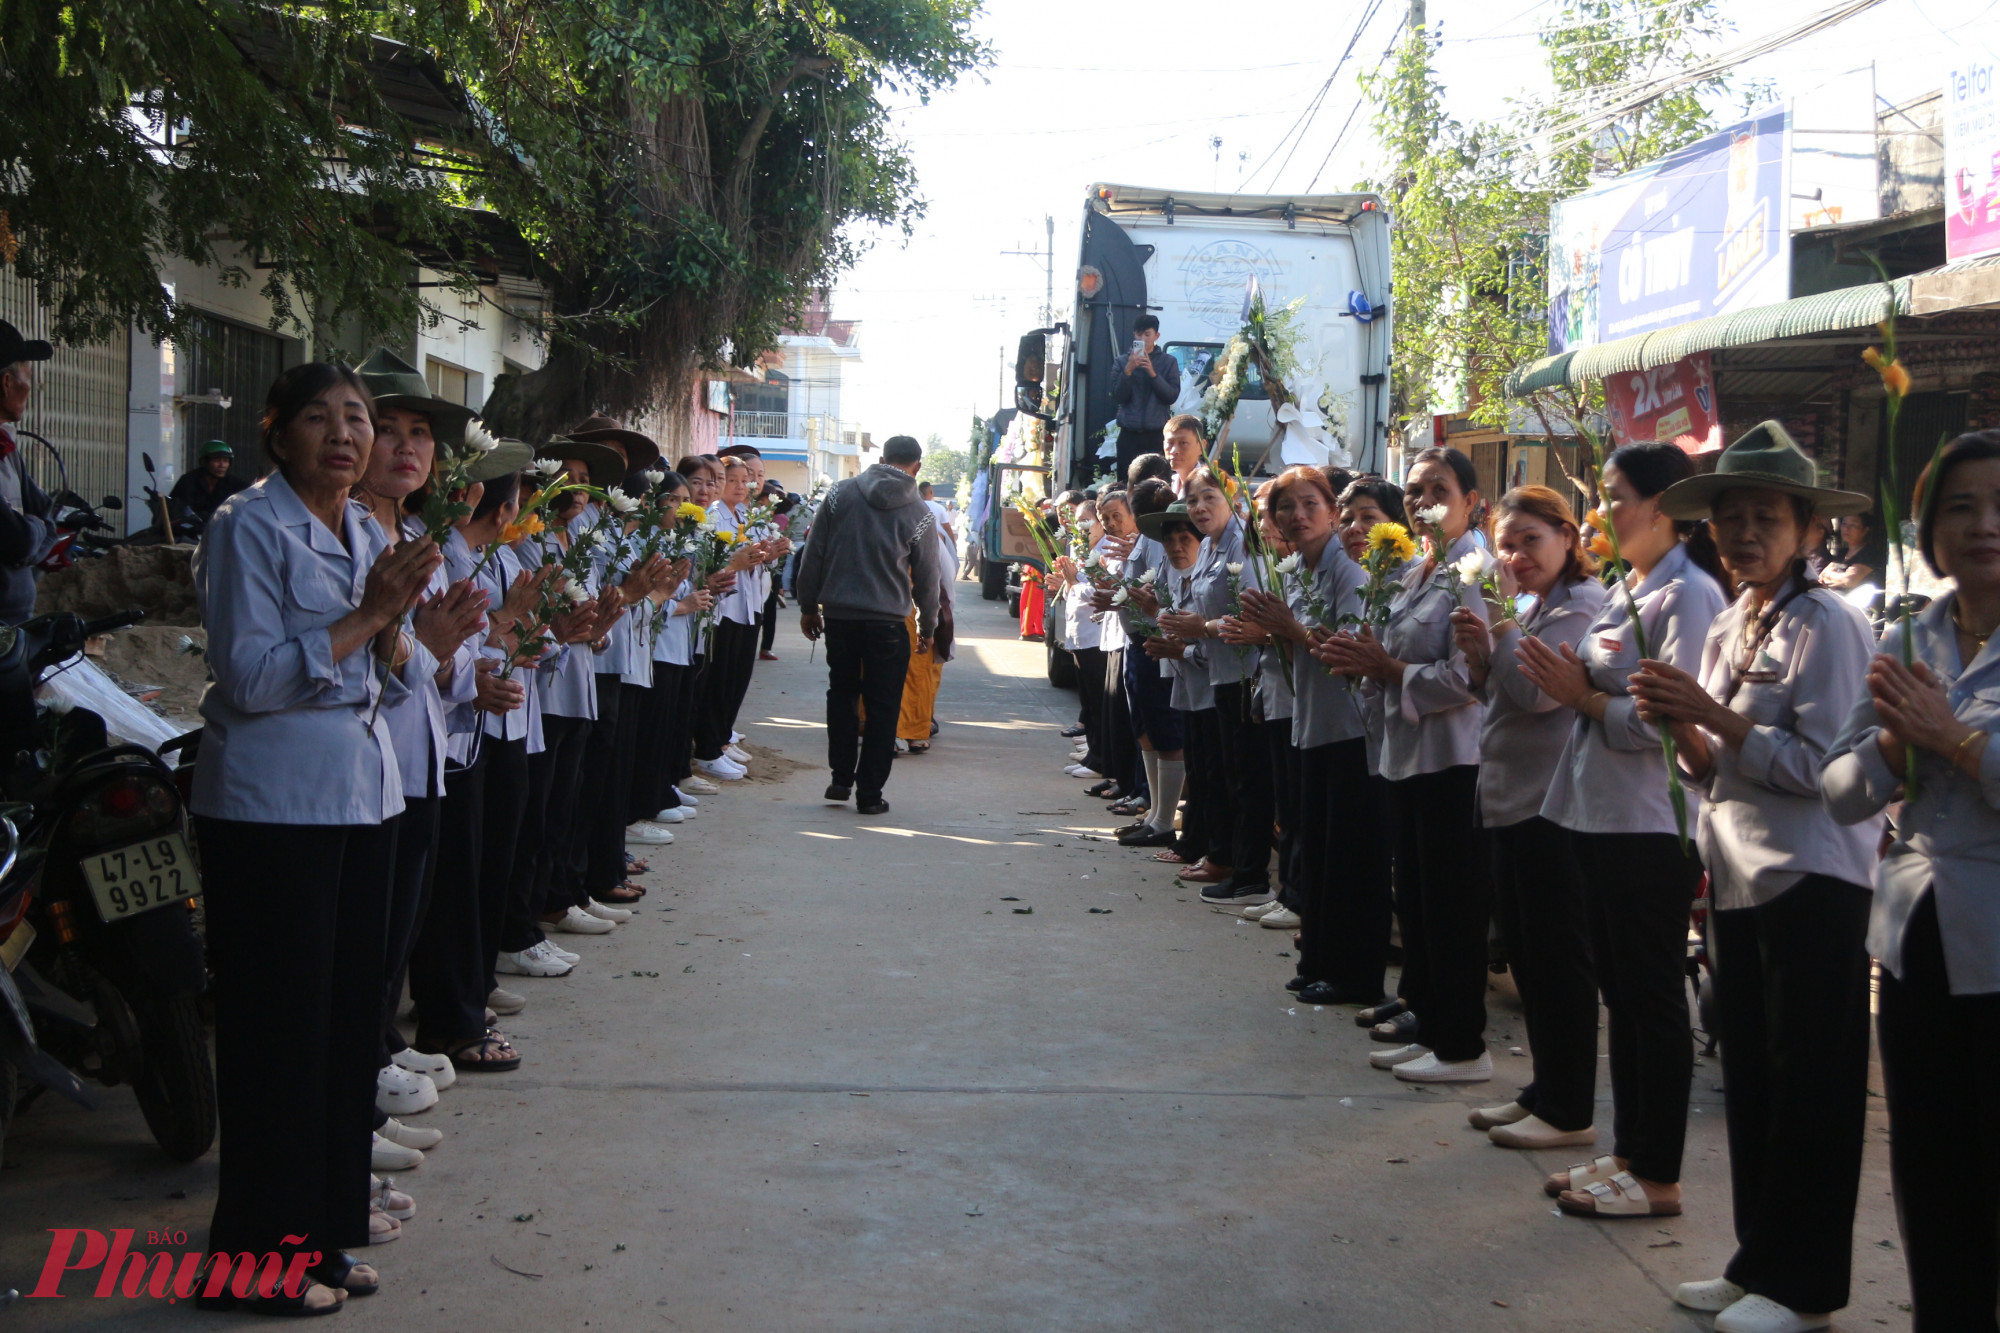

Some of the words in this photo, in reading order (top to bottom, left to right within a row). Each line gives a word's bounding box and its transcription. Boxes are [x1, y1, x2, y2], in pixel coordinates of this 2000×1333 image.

[1950, 62, 1994, 104] Telfor
[1717, 211, 1764, 291] LARUE
[1630, 368, 1662, 419] 2X
[100, 839, 177, 883] 47-L9
[109, 868, 189, 913] 9922
